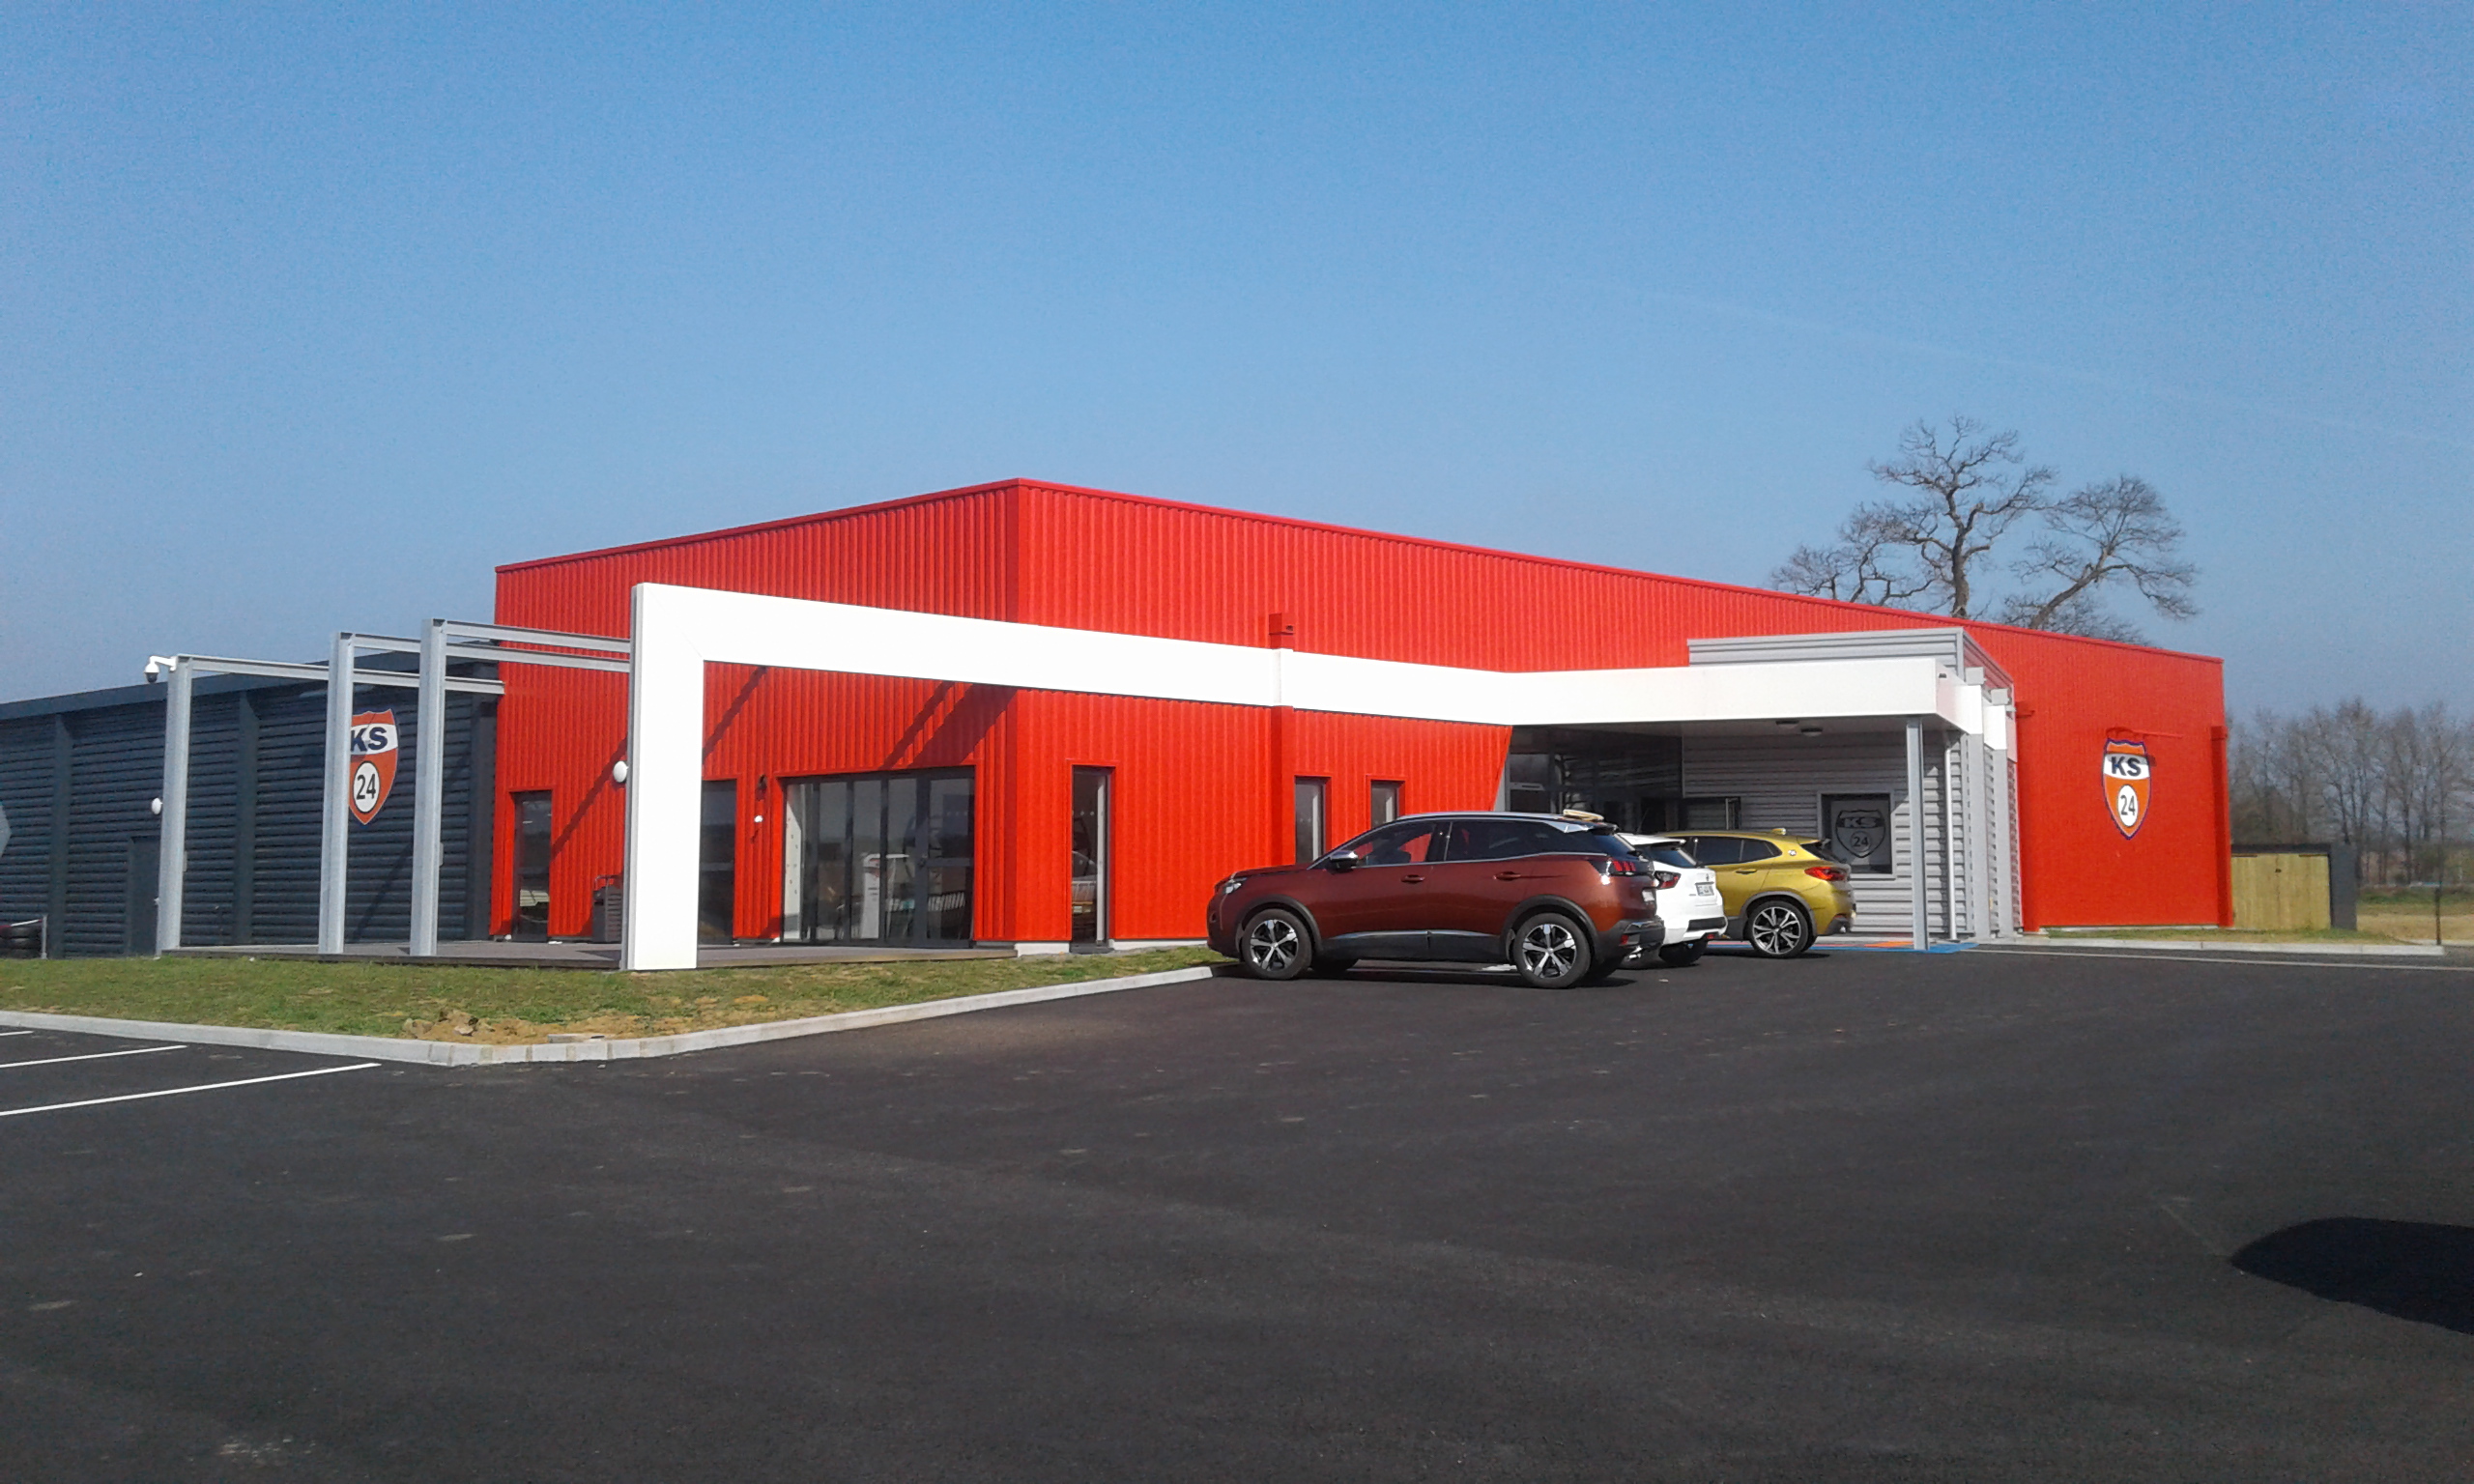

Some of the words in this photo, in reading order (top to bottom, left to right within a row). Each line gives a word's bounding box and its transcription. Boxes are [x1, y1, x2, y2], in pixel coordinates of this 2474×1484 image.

[350, 727, 388, 751] KS
[2111, 756, 2142, 777] KS
[356, 774, 376, 800] 24
[2120, 794, 2136, 815] 24
[1853, 837, 1869, 847] 24
